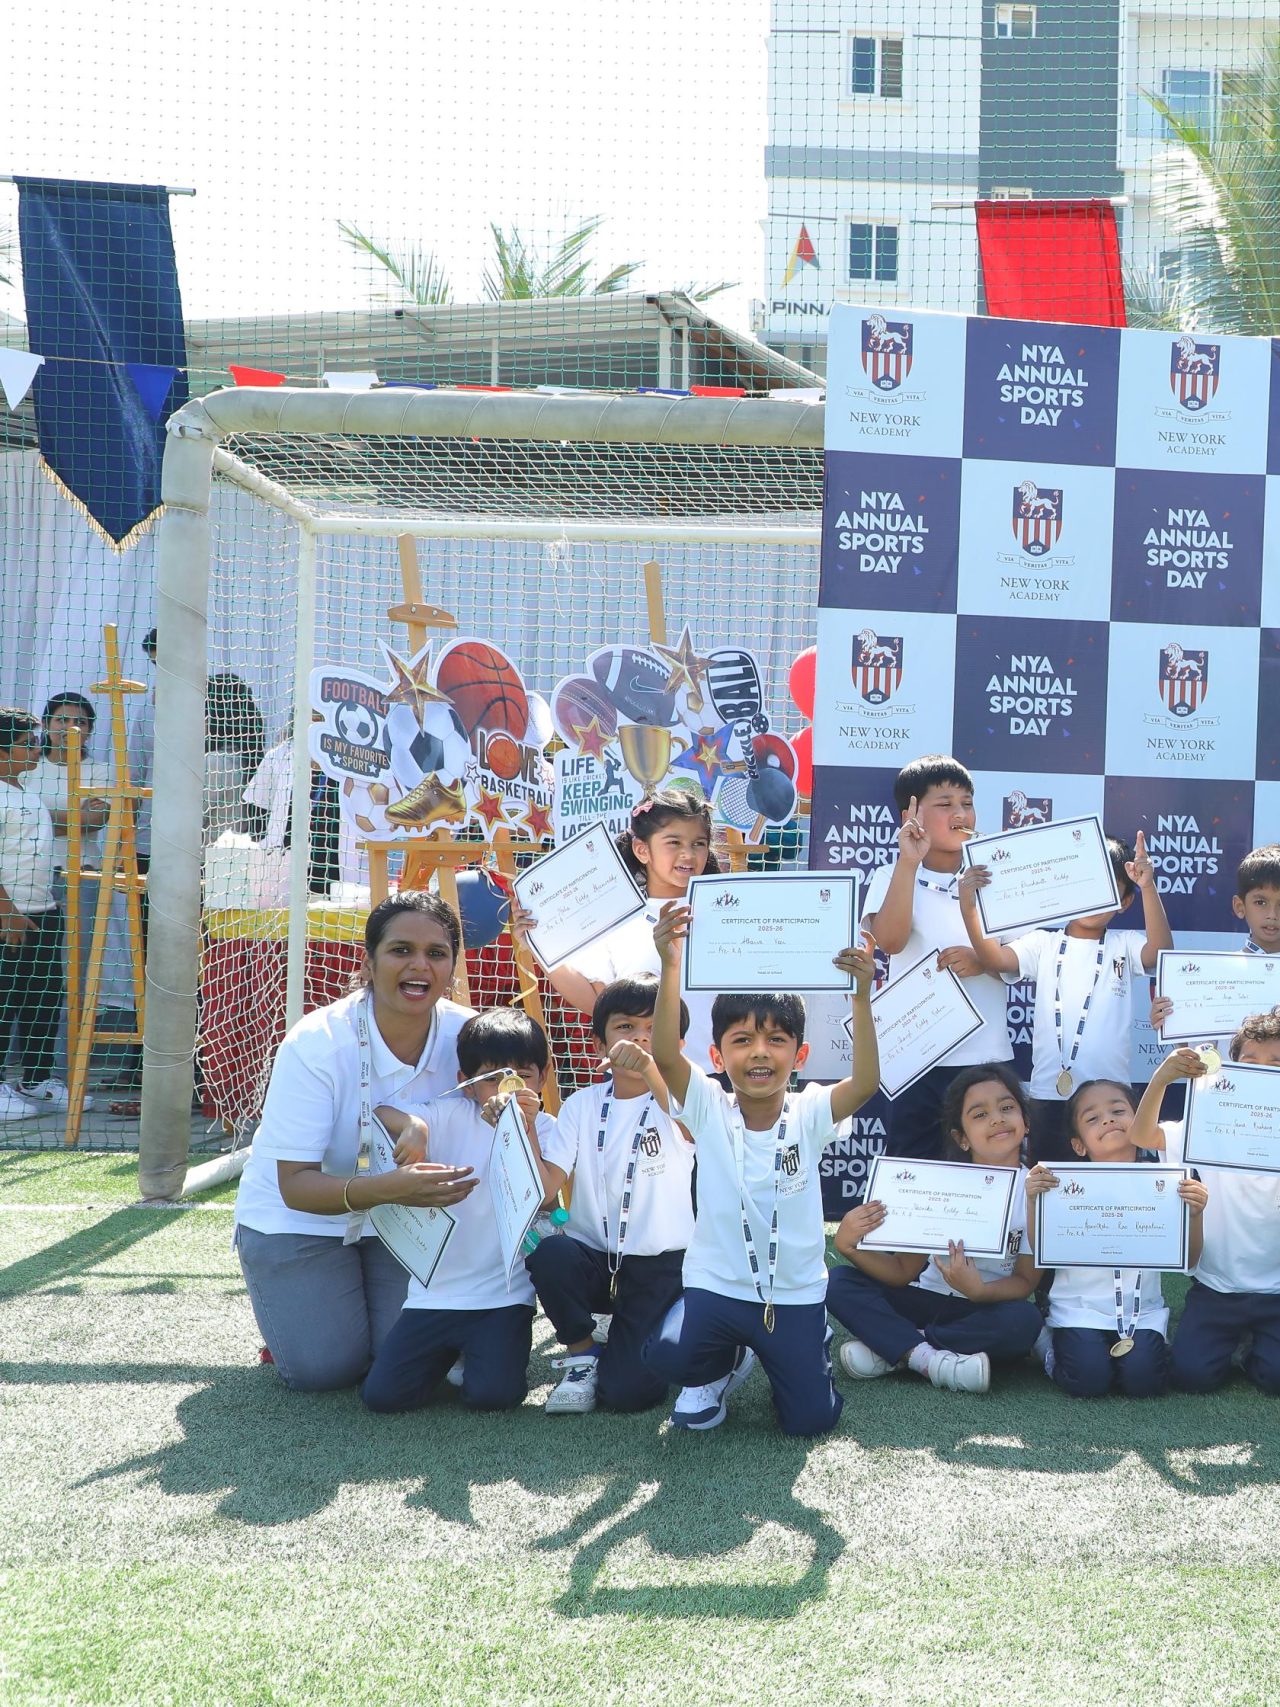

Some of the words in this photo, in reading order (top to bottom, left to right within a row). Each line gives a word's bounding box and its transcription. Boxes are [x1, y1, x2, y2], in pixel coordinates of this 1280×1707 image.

[773, 301, 831, 316] PINN
[1022, 344, 1065, 364] NYA
[997, 364, 1089, 387] ANNUAL
[999, 386, 1084, 408] SPORTS
[850, 411, 880, 424] NEW
[884, 413, 920, 427] YORK
[1020, 407, 1062, 427] DAY
[859, 427, 911, 437] ACADEMY
[1158, 432, 1187, 443] NEW
[1191, 433, 1226, 445] YORK
[1167, 445, 1216, 456] ACADEMY
[860, 491, 905, 511] NYA
[835, 511, 929, 533] ANNUAL
[1168, 509, 1210, 528] NYA
[838, 532, 924, 554] SPORTS
[1144, 528, 1233, 549] ANNUAL
[859, 554, 902, 574] DAY
[1146, 549, 1229, 570] SPORTS
[1001, 577, 1030, 589] NEW
[1034, 578, 1070, 590] YORK
[1167, 570, 1207, 589] DAY
[1009, 591, 1061, 601] ACADEMY
[1011, 655, 1054, 674] NYA
[708, 655, 759, 720] BALL
[986, 676, 1077, 696] ANNUAL
[989, 696, 1072, 717] SPORTS
[839, 726, 869, 738] NEW
[873, 727, 910, 739] YORK
[1009, 718, 1051, 737] DAY
[323, 737, 332, 749] IS
[334, 740, 349, 754] MY
[350, 746, 388, 766] FAVORITE
[848, 740, 901, 750] ACADEMY
[1147, 739, 1176, 750] NEW
[1180, 739, 1215, 751] YORK
[342, 756, 368, 772] SPORT
[1156, 752, 1206, 761] ACADEMY
[561, 757, 595, 777] LIFE
[562, 781, 601, 800] KEEP
[560, 793, 633, 817] SWINGING
[850, 805, 894, 823] NYA
[1158, 815, 1200, 833] NYA
[824, 825, 900, 844] ANNUA
[829, 846, 900, 865] SPORT
[1150, 855, 1218, 874] PORTS
[1157, 876, 1197, 894] DAY
[721, 917, 761, 925] CERTIFICATE
[1218, 1101, 1253, 1110] CERTIFICATE
